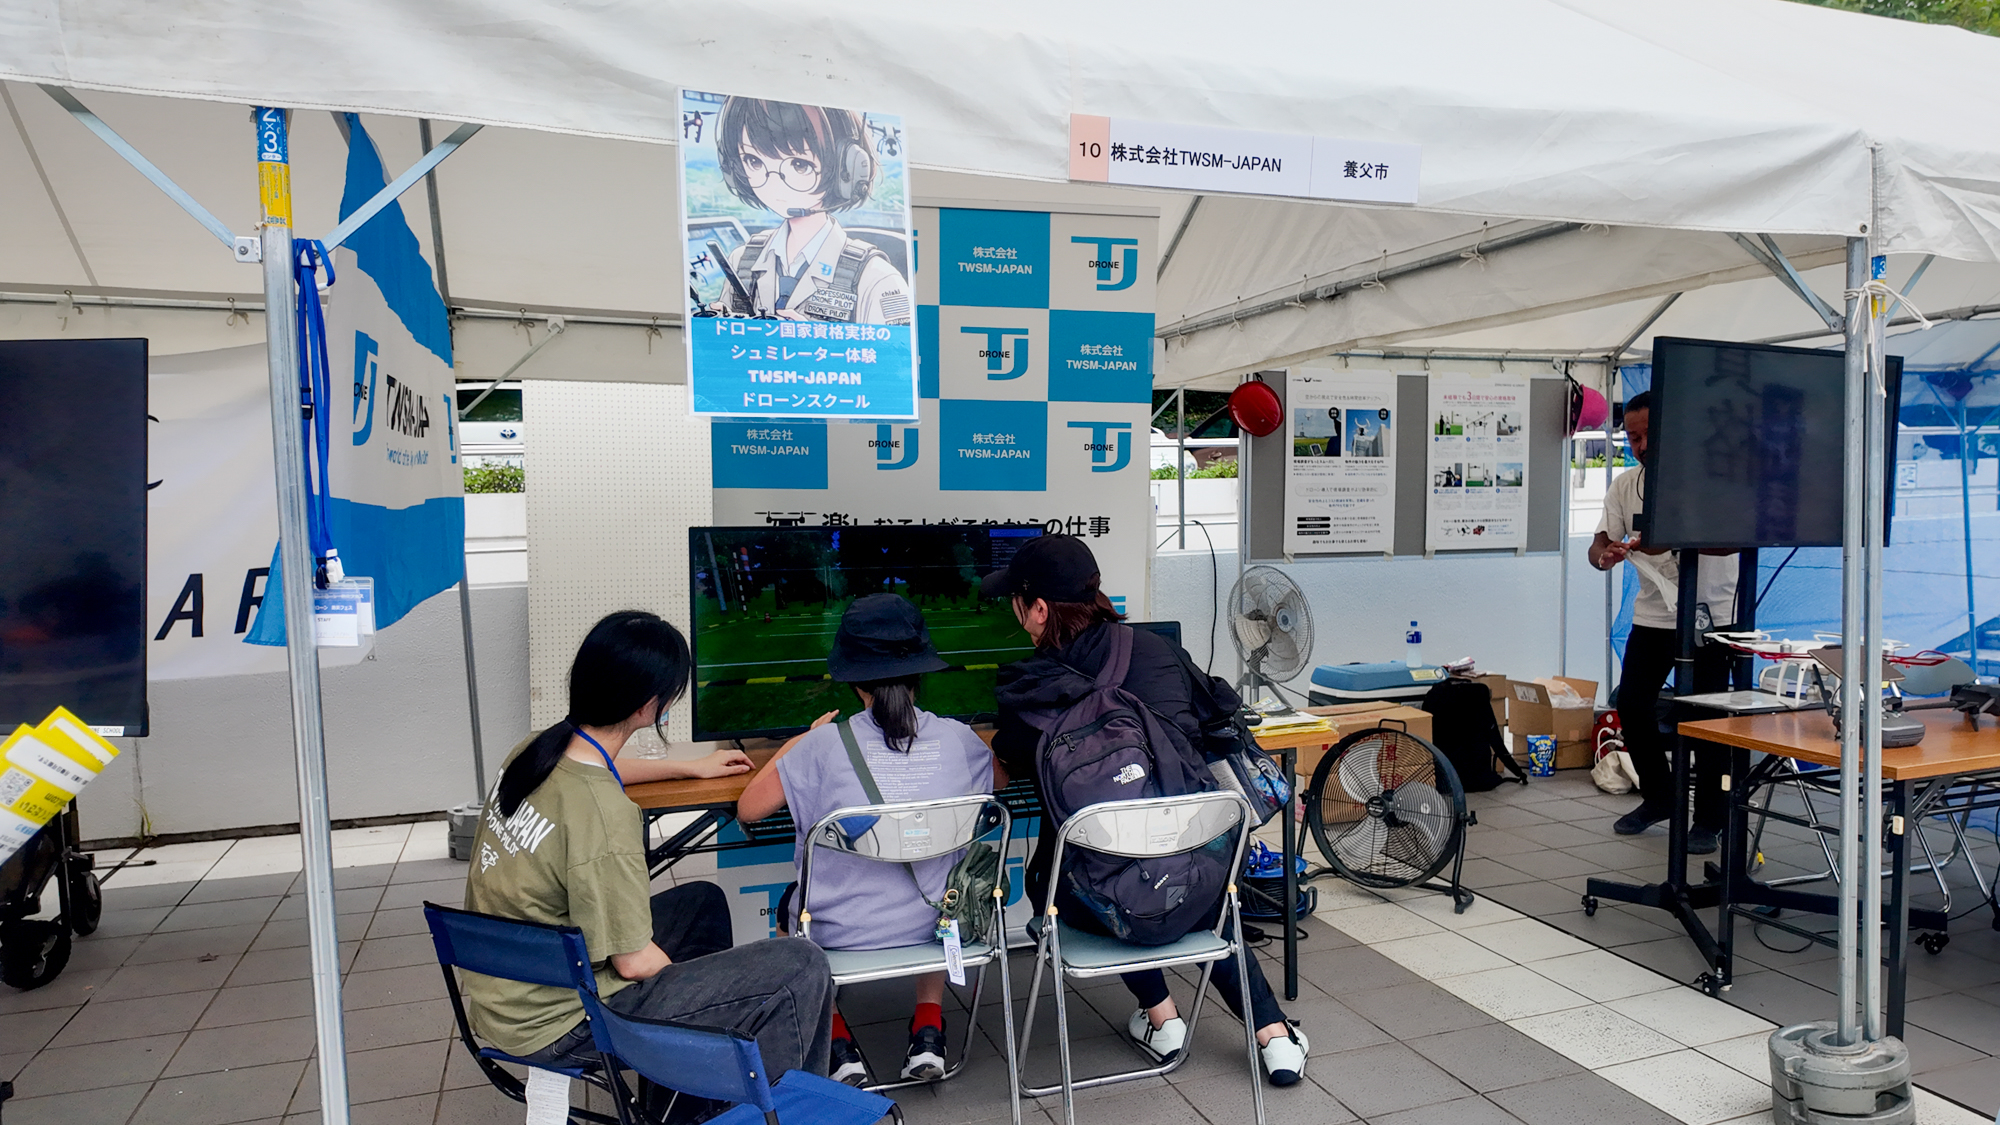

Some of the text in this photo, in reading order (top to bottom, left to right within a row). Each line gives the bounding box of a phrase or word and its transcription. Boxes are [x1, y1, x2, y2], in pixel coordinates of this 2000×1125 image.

[1079, 142, 1389, 180] 10 株式会社TWSM-JAPAN 養父市
[973, 246, 1017, 260] 株式会社
[958, 262, 1032, 275] TWSM-JAPAN
[1088, 260, 1119, 269] DRONE
[715, 321, 891, 341] ドローン国家資格実技の
[731, 345, 877, 364] シュミレーター体験
[979, 350, 1010, 359] DRONE
[1080, 344, 1123, 357] 株式会社
[1066, 360, 1137, 371] TWSM-JAPAN
[748, 369, 862, 385] TWSM-JAPAN
[742, 392, 871, 409] ドローンスクール
[746, 428, 793, 441] 株式会社
[972, 433, 1016, 445] 株式会社
[731, 444, 809, 456] TWSM-JAPAN
[868, 440, 900, 449] DRONE
[1084, 443, 1114, 452] DRONE
[958, 449, 1030, 460] TWSM-JAPAN
[500, 831, 520, 858] PILOT
